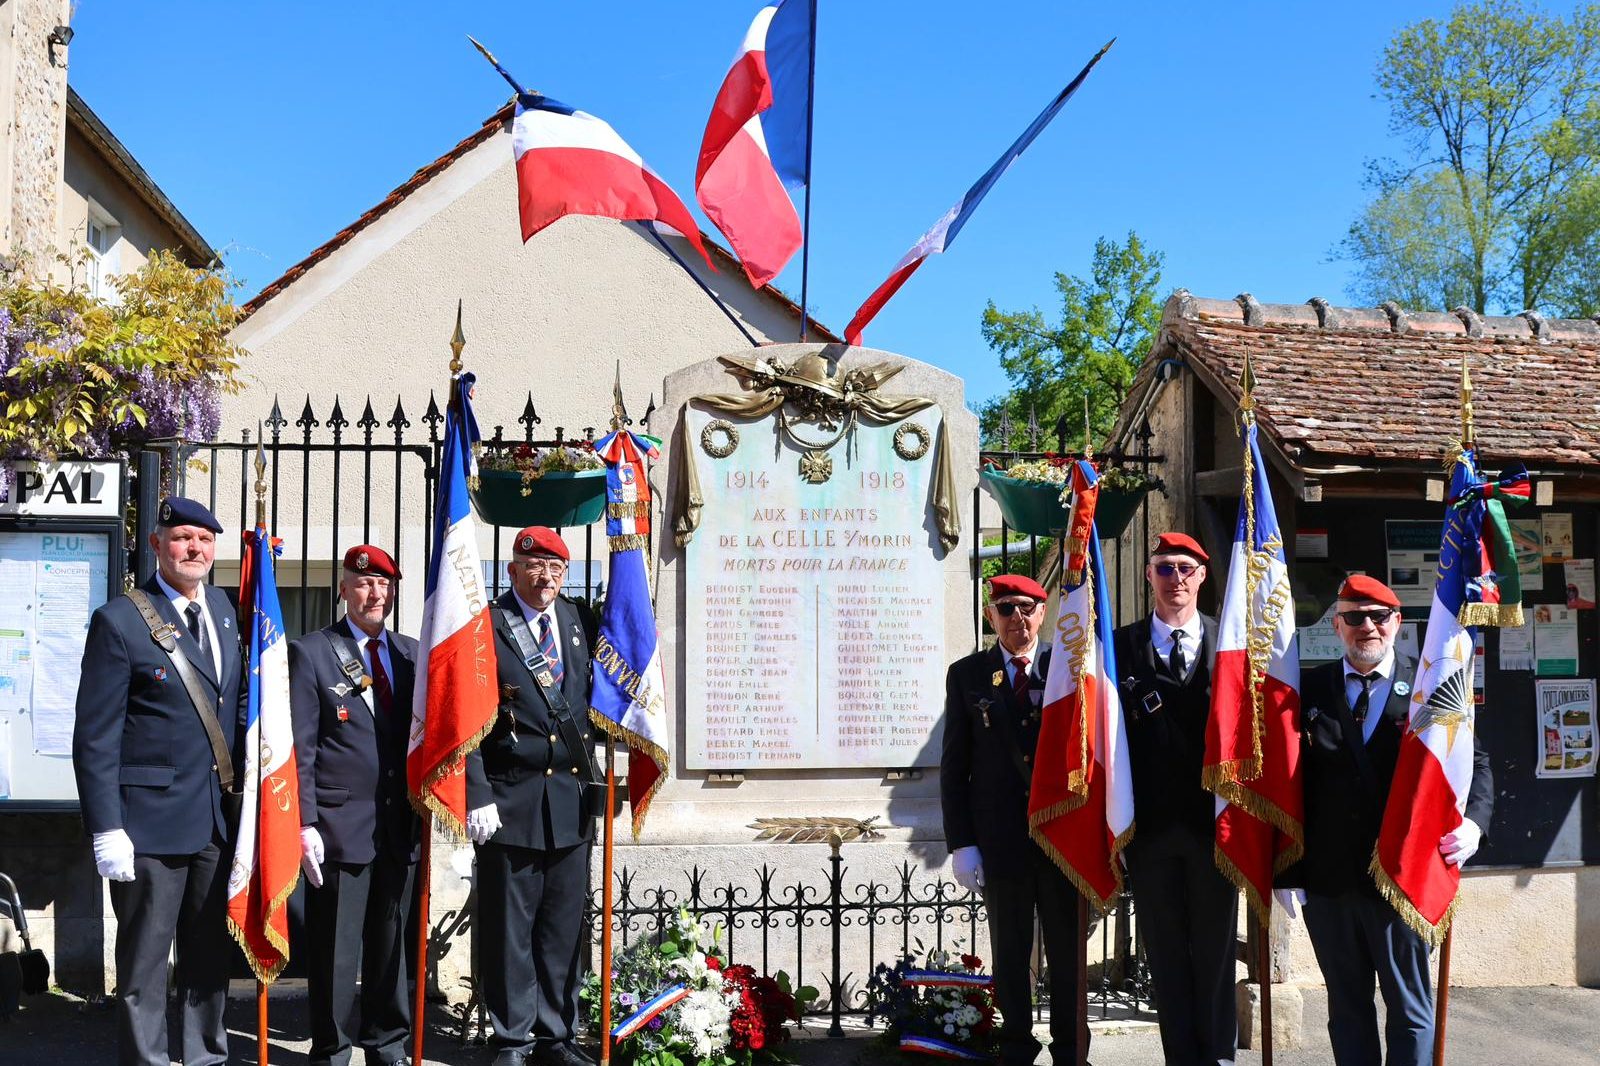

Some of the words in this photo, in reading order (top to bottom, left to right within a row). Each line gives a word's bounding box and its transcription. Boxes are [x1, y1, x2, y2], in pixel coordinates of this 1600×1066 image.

[0, 471, 103, 504] PAL
[725, 471, 770, 489] 1914
[859, 471, 905, 489] 1918
[753, 508, 786, 521] AUX
[801, 508, 878, 521] ENFANTS
[42, 536, 84, 551] PLUi
[720, 535, 738, 548] DE
[747, 535, 765, 548] LA
[772, 529, 836, 548] CELLE
[724, 558, 776, 571] MORTS
[782, 558, 822, 571] POUR
[828, 558, 847, 571] LA
[850, 557, 908, 571] FRANCE
[447, 543, 487, 688] NATIONALE
